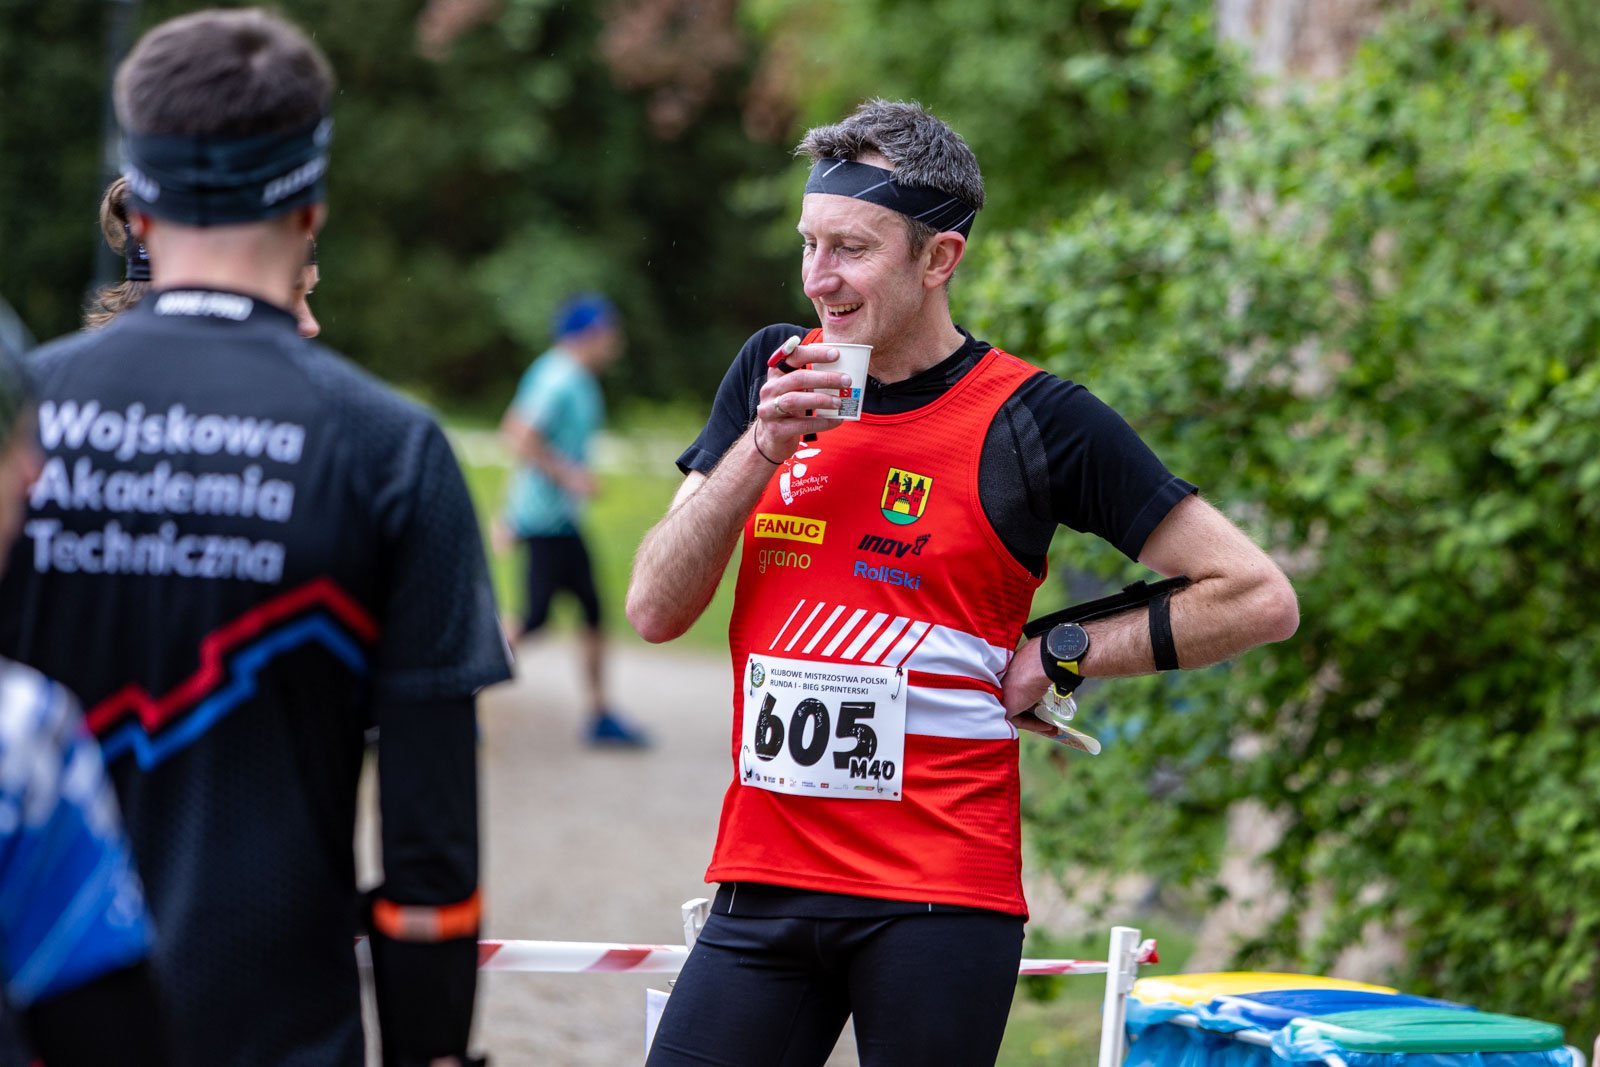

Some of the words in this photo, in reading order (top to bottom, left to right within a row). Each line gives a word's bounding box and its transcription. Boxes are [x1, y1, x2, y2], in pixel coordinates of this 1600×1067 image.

[39, 401, 305, 463] Wojskowa
[30, 456, 295, 522] Akademia
[756, 518, 821, 539] FANUC
[25, 519, 286, 583] Techniczna
[758, 549, 812, 574] grano
[853, 560, 921, 591] RollSki
[769, 679, 793, 688] RUNDA
[802, 682, 819, 692] BIEG
[820, 684, 869, 695] SPRINTERSKI
[770, 668, 803, 679] KLUBOWE
[804, 672, 859, 684] MISTRZOSTWA
[860, 677, 888, 686] POLSKI
[755, 692, 878, 770] 605
[850, 757, 896, 781] M40
